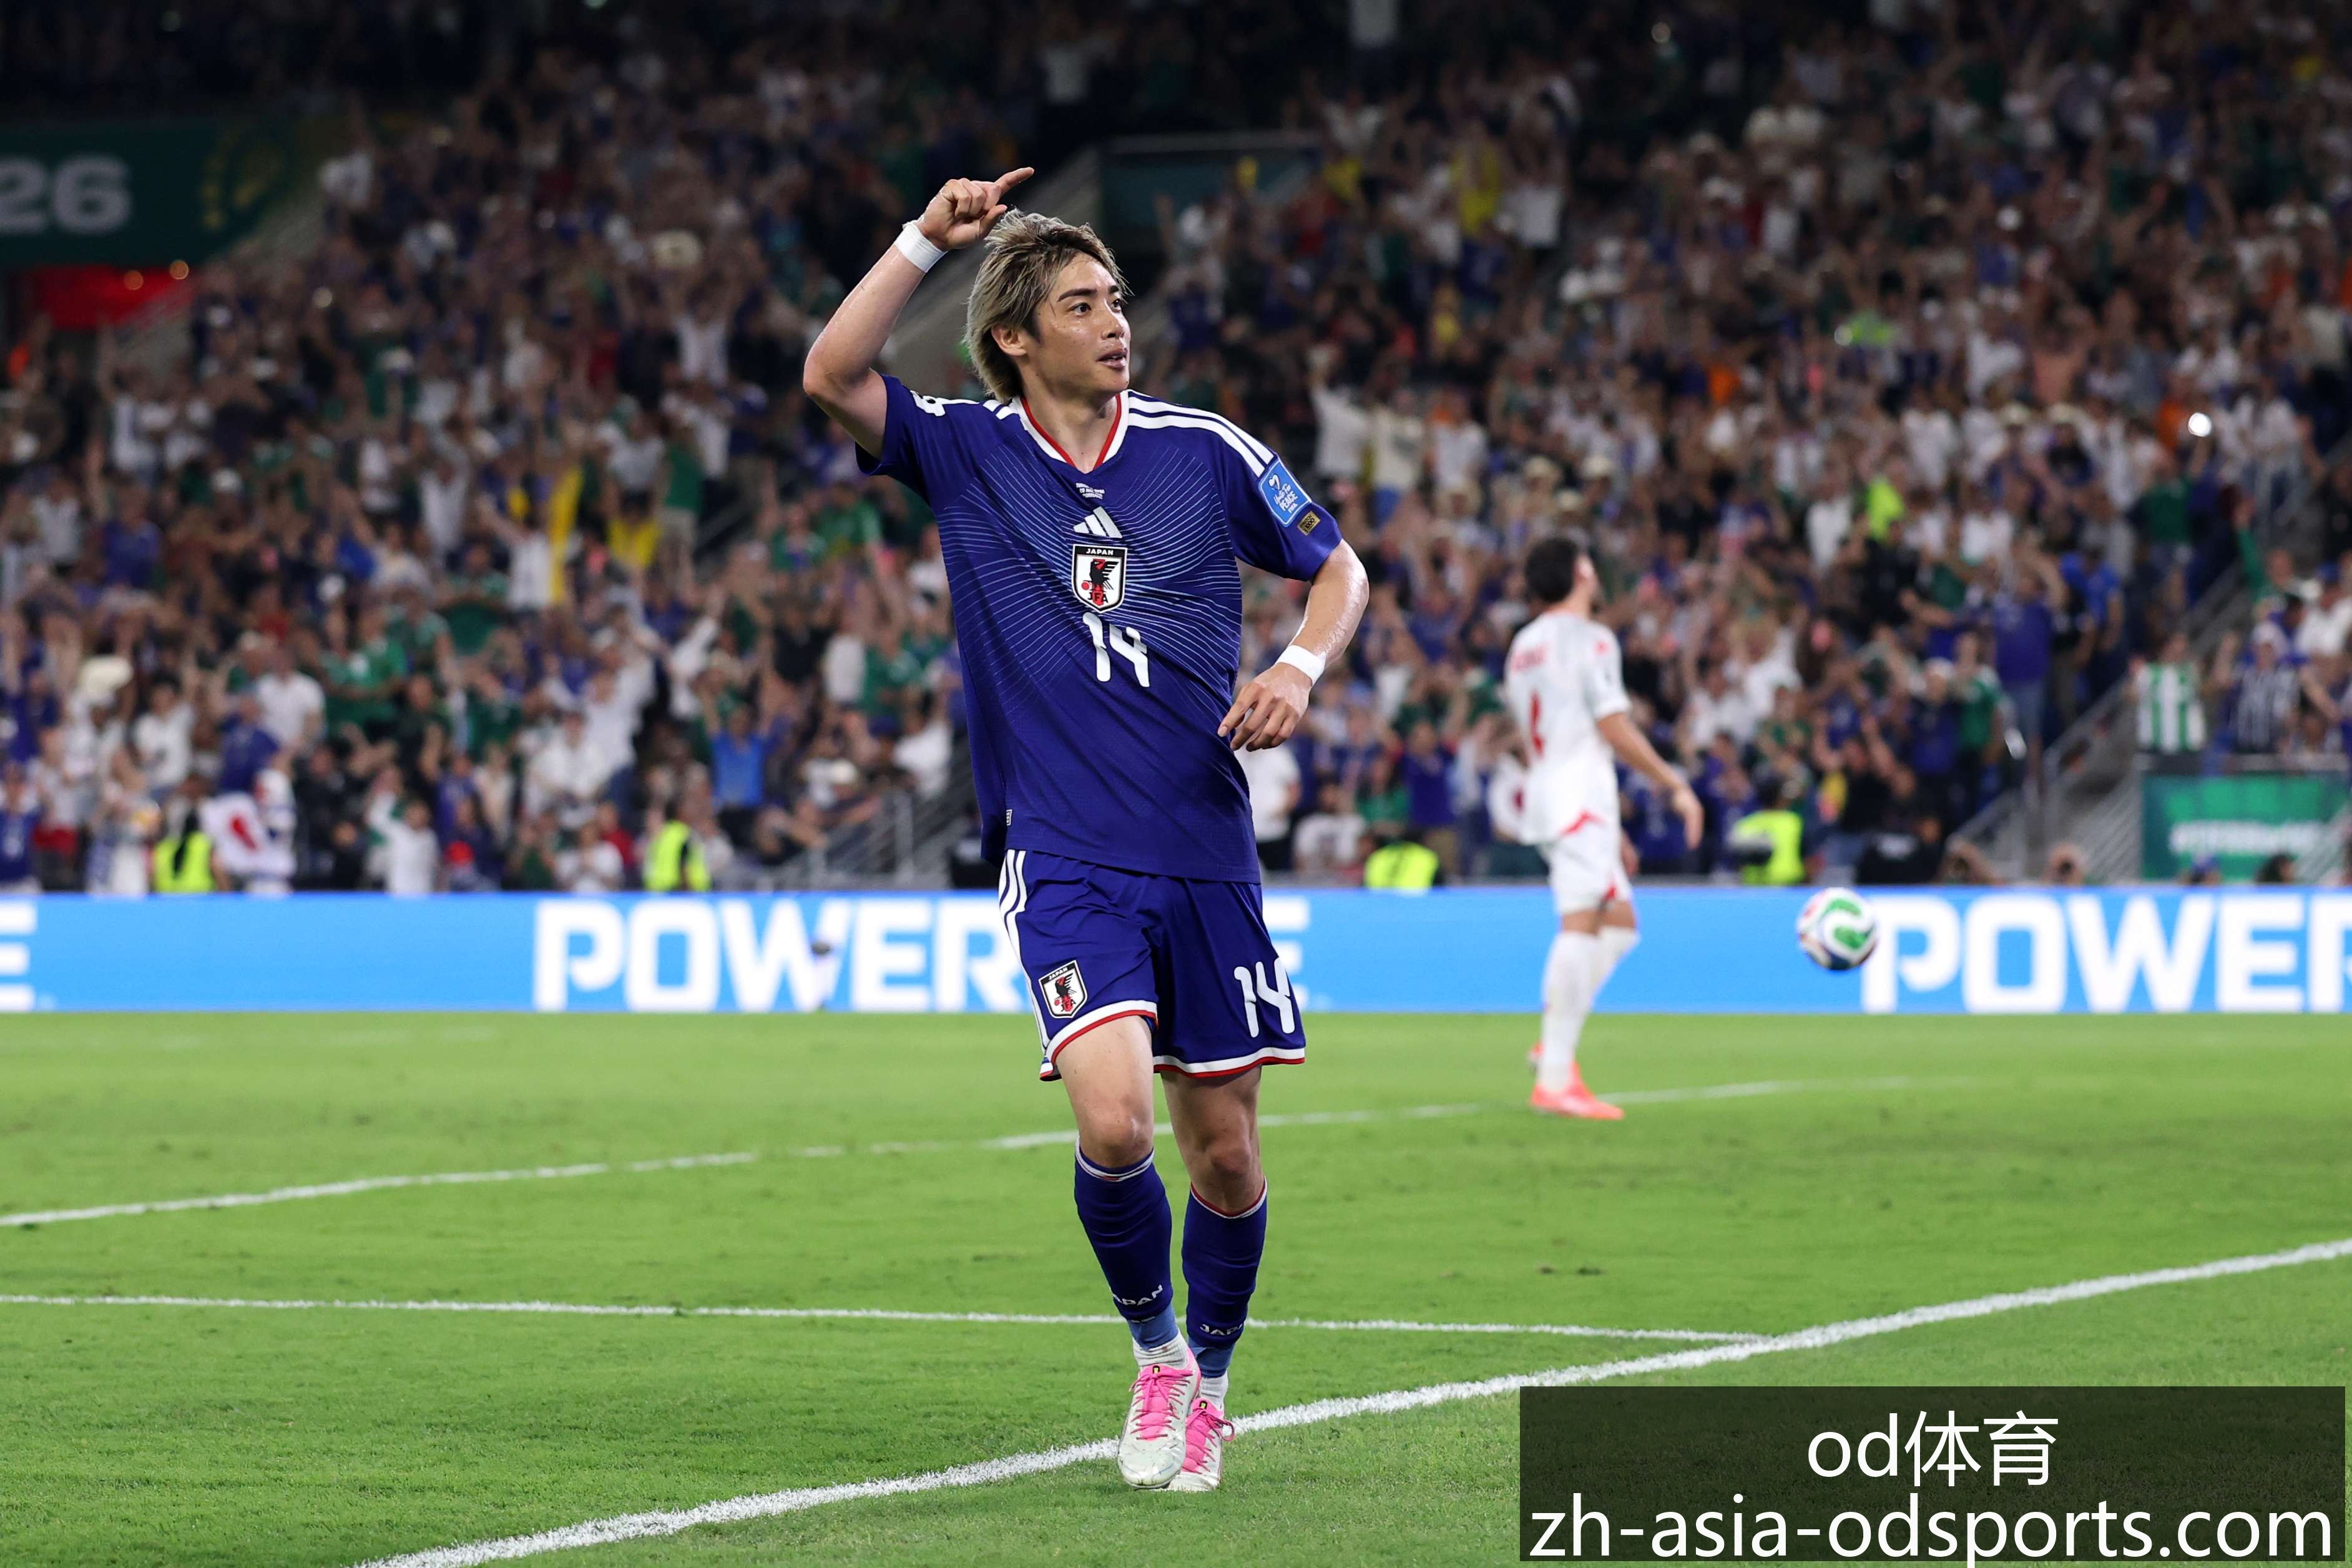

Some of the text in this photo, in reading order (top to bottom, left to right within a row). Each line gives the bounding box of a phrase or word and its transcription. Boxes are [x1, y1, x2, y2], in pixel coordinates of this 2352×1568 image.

[0, 154, 130, 237] 26
[1279, 491, 1298, 511] PEACE
[1087, 591, 1109, 604] JFA
[1082, 612, 1150, 687] 14
[1049, 967, 1068, 980] JAPAN
[1233, 956, 1295, 1038] 14
[1112, 1284, 1163, 1306] APAN
